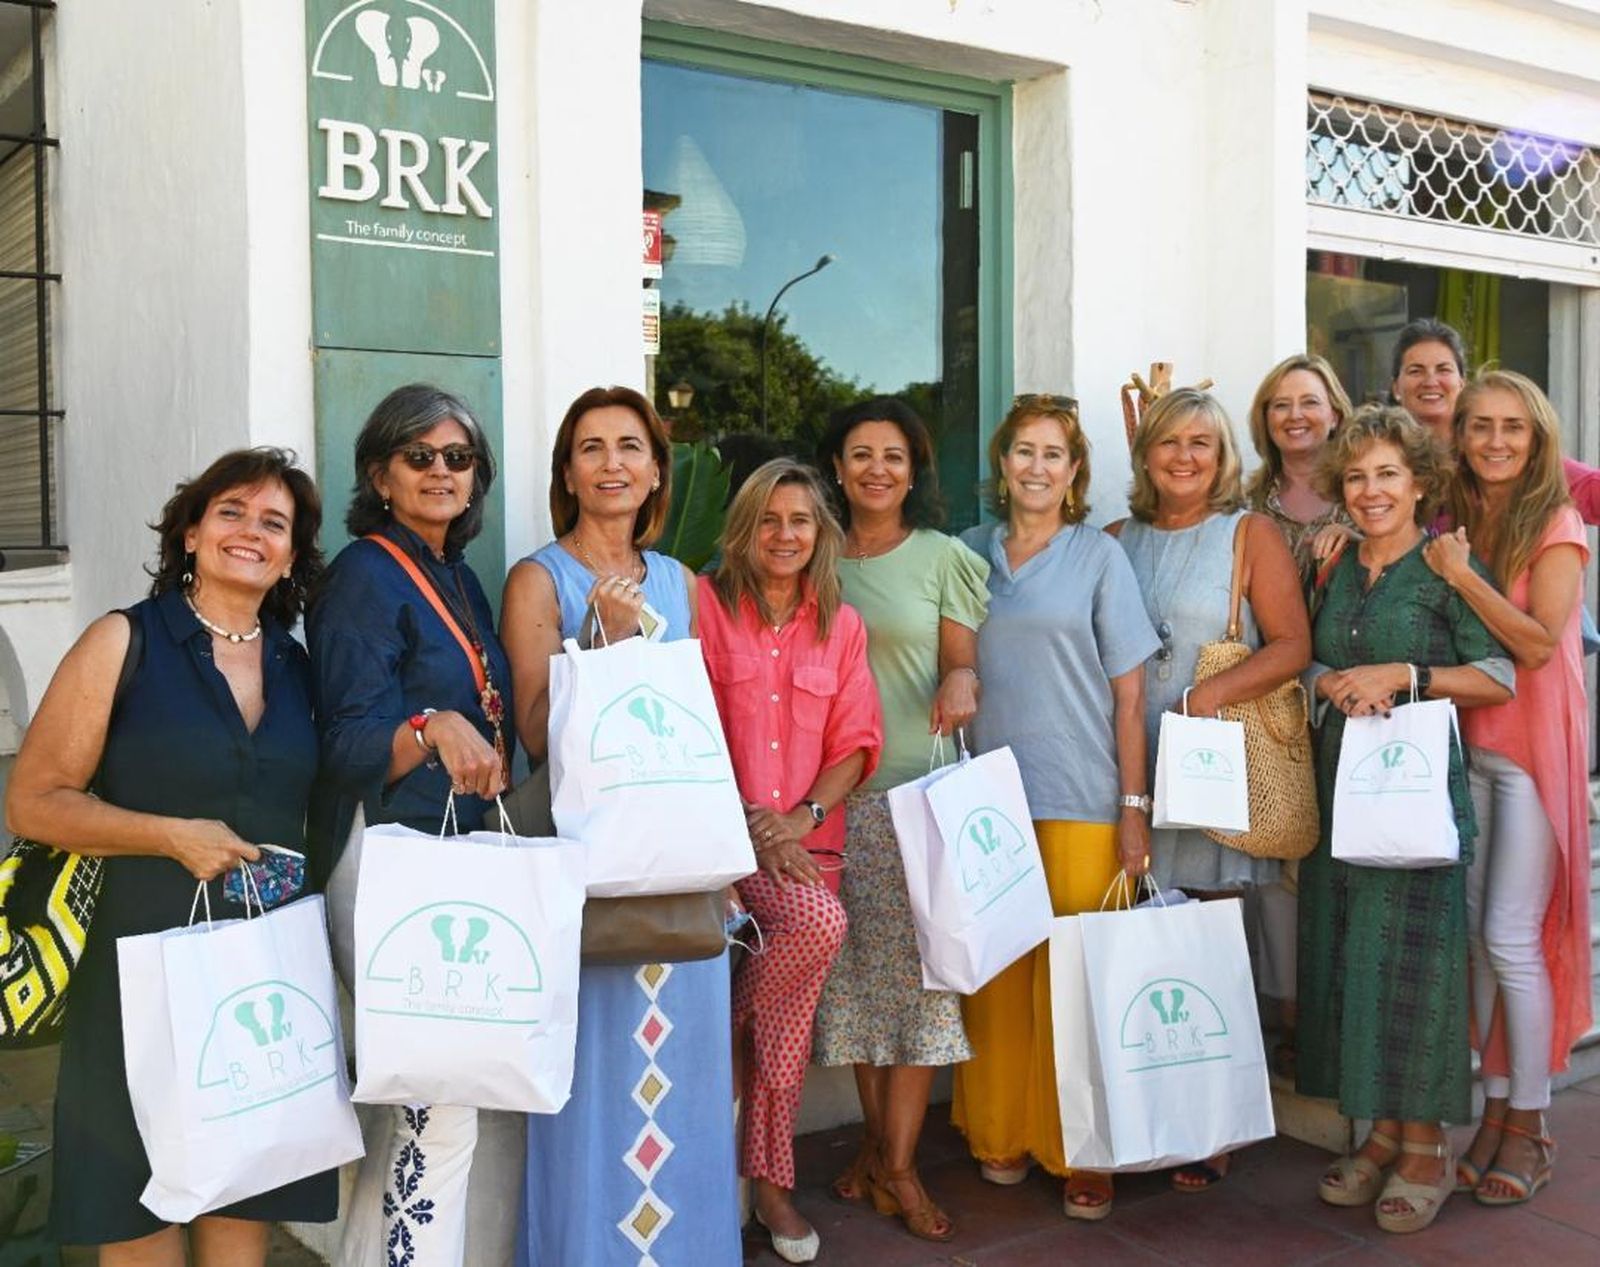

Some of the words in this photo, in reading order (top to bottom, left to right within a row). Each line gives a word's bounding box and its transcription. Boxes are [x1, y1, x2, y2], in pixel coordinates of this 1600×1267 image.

[318, 118, 492, 218] BRK
[345, 219, 371, 236] The
[373, 222, 415, 242] family
[416, 229, 468, 247] concept
[408, 966, 501, 1002] BRK
